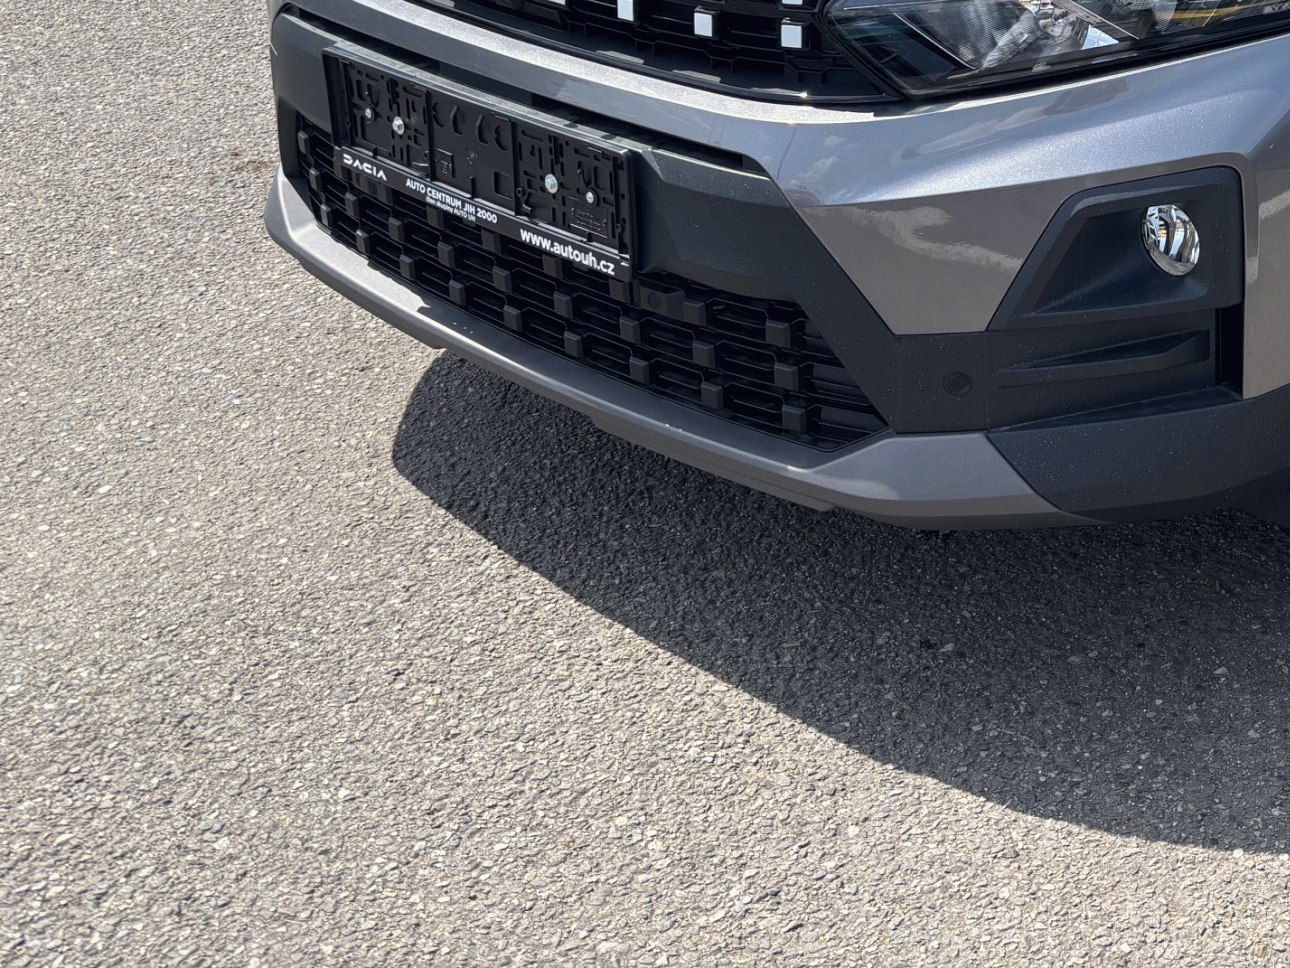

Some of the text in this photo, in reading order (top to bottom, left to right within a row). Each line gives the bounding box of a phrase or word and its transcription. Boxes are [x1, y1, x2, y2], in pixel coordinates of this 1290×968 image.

[342, 153, 387, 181] DACIA
[406, 178, 498, 224] AUTO CENTRUM JIH 2000
[520, 228, 615, 276] www.autouh.cz
